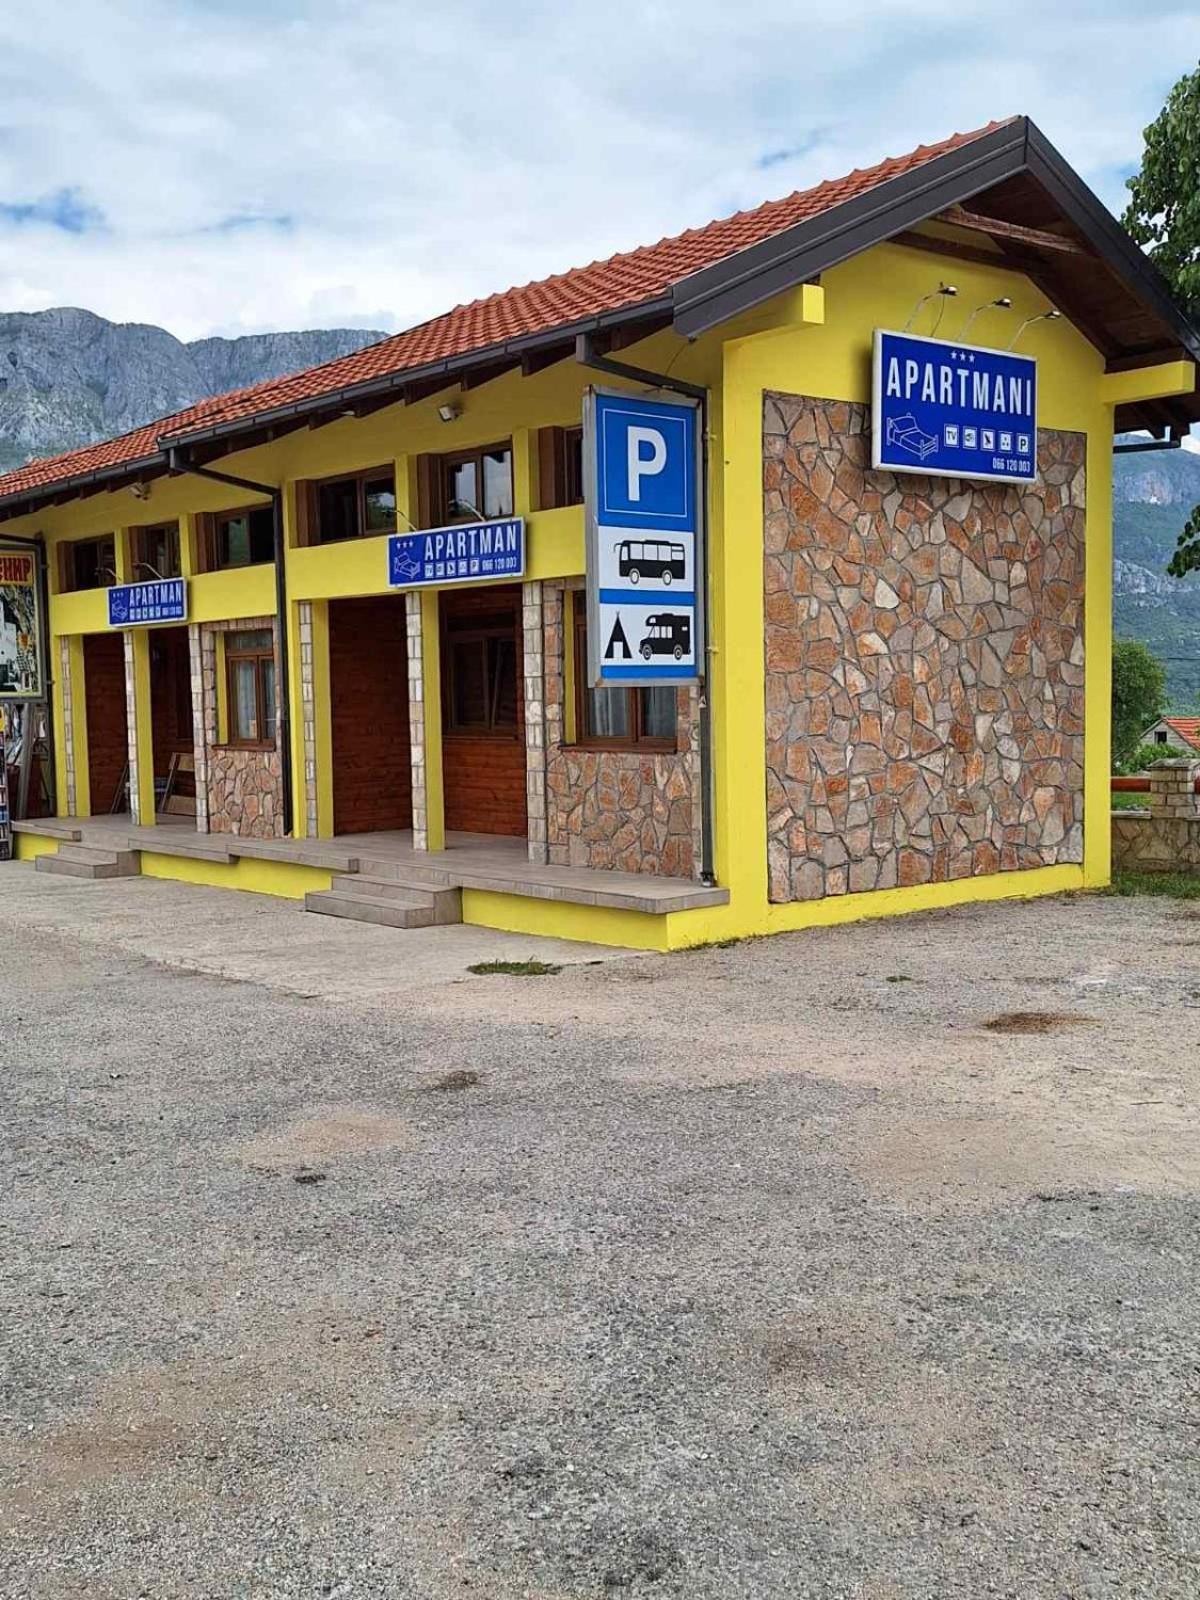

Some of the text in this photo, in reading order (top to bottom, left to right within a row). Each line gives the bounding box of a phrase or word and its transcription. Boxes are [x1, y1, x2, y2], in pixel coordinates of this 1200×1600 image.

[886, 357, 1032, 416] APARTMANI
[627, 425, 667, 502] P
[992, 457, 1031, 473] 066 120 003
[424, 524, 517, 561] APARTMAN
[494, 558, 505, 570] 120
[129, 582, 182, 607] APARTMAN
